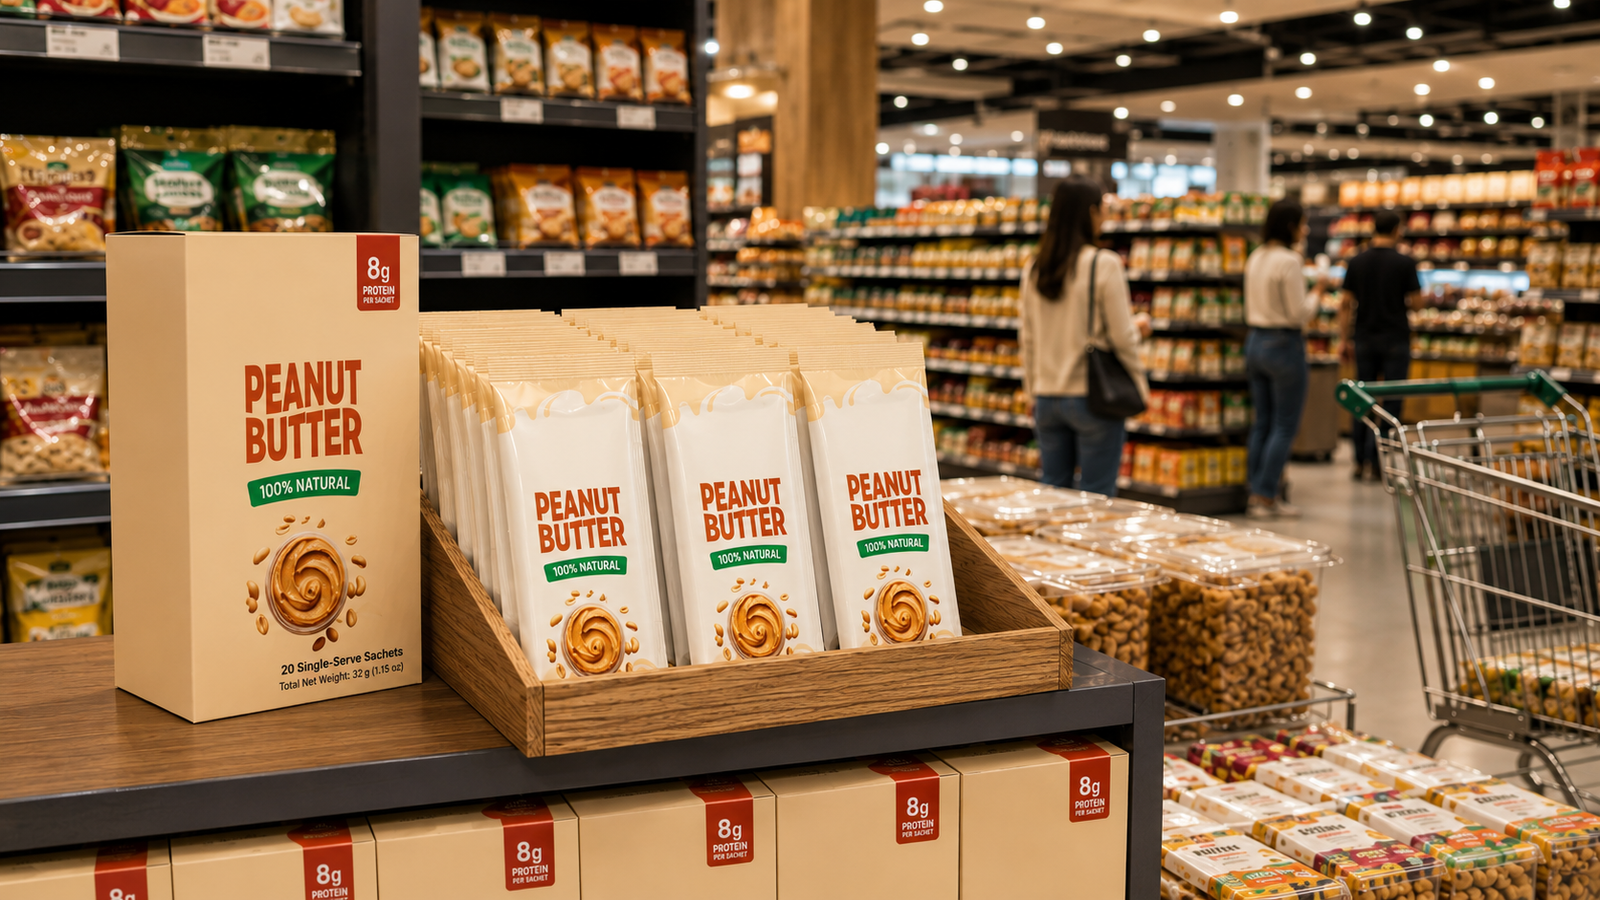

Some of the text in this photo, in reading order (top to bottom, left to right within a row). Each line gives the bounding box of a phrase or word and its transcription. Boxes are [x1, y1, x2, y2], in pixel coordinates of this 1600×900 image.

[367, 256, 390, 283] 8g
[362, 285, 395, 295] PROTEIN
[363, 296, 374, 304] PER
[245, 359, 362, 415] PEANUT
[245, 407, 363, 464] BUTTER
[259, 476, 351, 499] 100% NATURAL
[699, 477, 781, 512] PEANUT
[845, 469, 921, 502] PEANUT
[534, 486, 620, 522] PEANUT
[850, 497, 929, 531] BUTTER
[538, 516, 627, 553] BUTTER
[703, 506, 788, 542] BUTTER
[717, 549, 782, 565] 100% NATURAL
[864, 538, 924, 553] 100% NATURAL
[552, 560, 621, 577] 100% NATURAL
[281, 647, 404, 675] 20 Single-Serve Sachets
[279, 661, 404, 691] Total Net Weight: 32 g (1.15 oz)
[1079, 776, 1100, 797] 8g
[906, 797, 929, 818] 8g
[1074, 798, 1105, 809] PROTEIN
[717, 818, 742, 841] 8g
[902, 819, 934, 831] PROTEIN
[516, 841, 542, 864] 8g
[713, 841, 748, 853] PROTEIN
[713, 853, 725, 861] PER
[316, 863, 342, 887] 8g
[512, 864, 549, 877] PROTEIN
[512, 877, 525, 885] PER
[311, 887, 348, 900] PROTEIN
